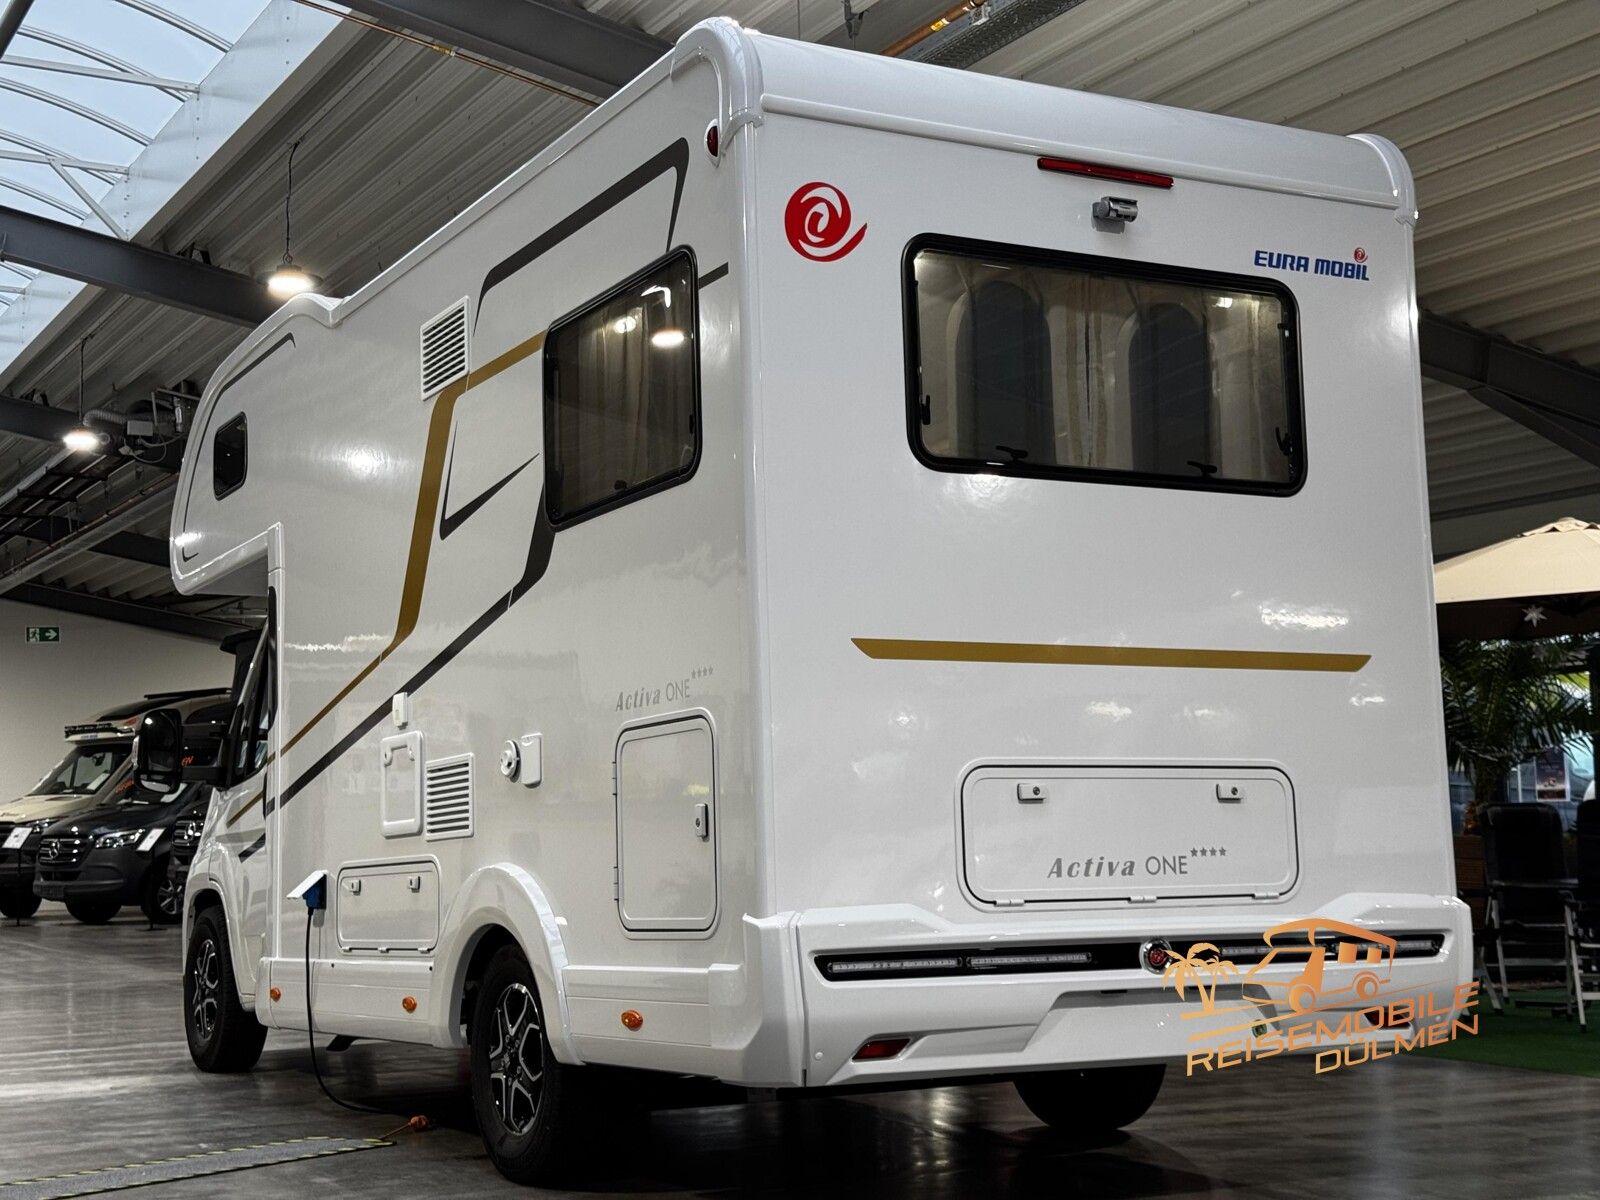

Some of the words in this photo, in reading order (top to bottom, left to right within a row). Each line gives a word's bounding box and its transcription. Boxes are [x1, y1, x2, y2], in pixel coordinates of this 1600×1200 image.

[1254, 250, 1309, 272] EURA
[1314, 258, 1369, 281] MOBIL
[616, 687, 660, 711] Activa
[666, 679, 690, 701] ONE
[1047, 856, 1135, 878] Activa
[1145, 855, 1188, 875] ONE
